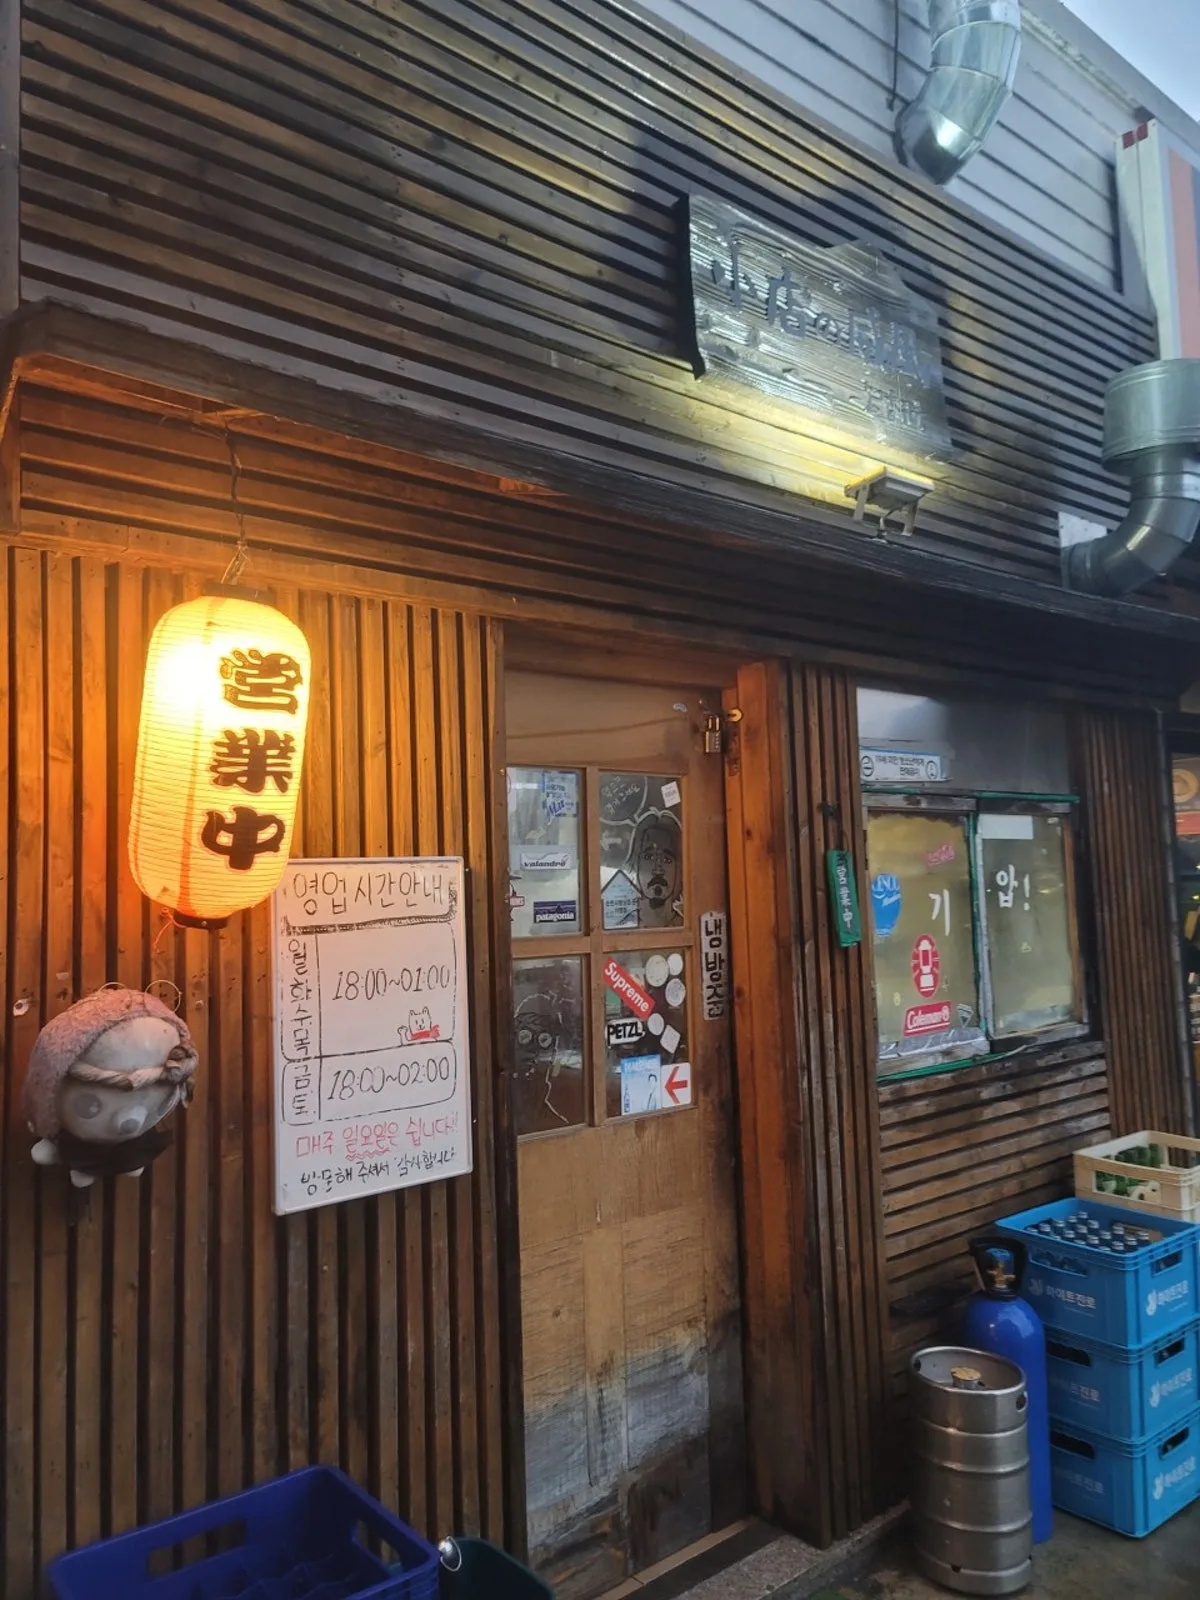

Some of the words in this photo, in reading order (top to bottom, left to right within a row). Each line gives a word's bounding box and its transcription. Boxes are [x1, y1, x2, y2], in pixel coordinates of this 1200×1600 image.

[535, 910, 575, 923] patagonia
[927, 888, 951, 937] 기
[604, 961, 650, 1013] Supreme
[704, 918, 726, 1019] 냉방중
[607, 1020, 644, 1046] PETZL
[906, 1009, 942, 1030] Coleman
[327, 1056, 450, 1101] 18:00~02:00
[295, 1130, 335, 1158] 매주
[342, 1120, 400, 1154] 일요일은
[300, 1166, 353, 1197] 방문해
[357, 1160, 391, 1184] 주셔서
[1046, 1285, 1098, 1310] 하이트진로
